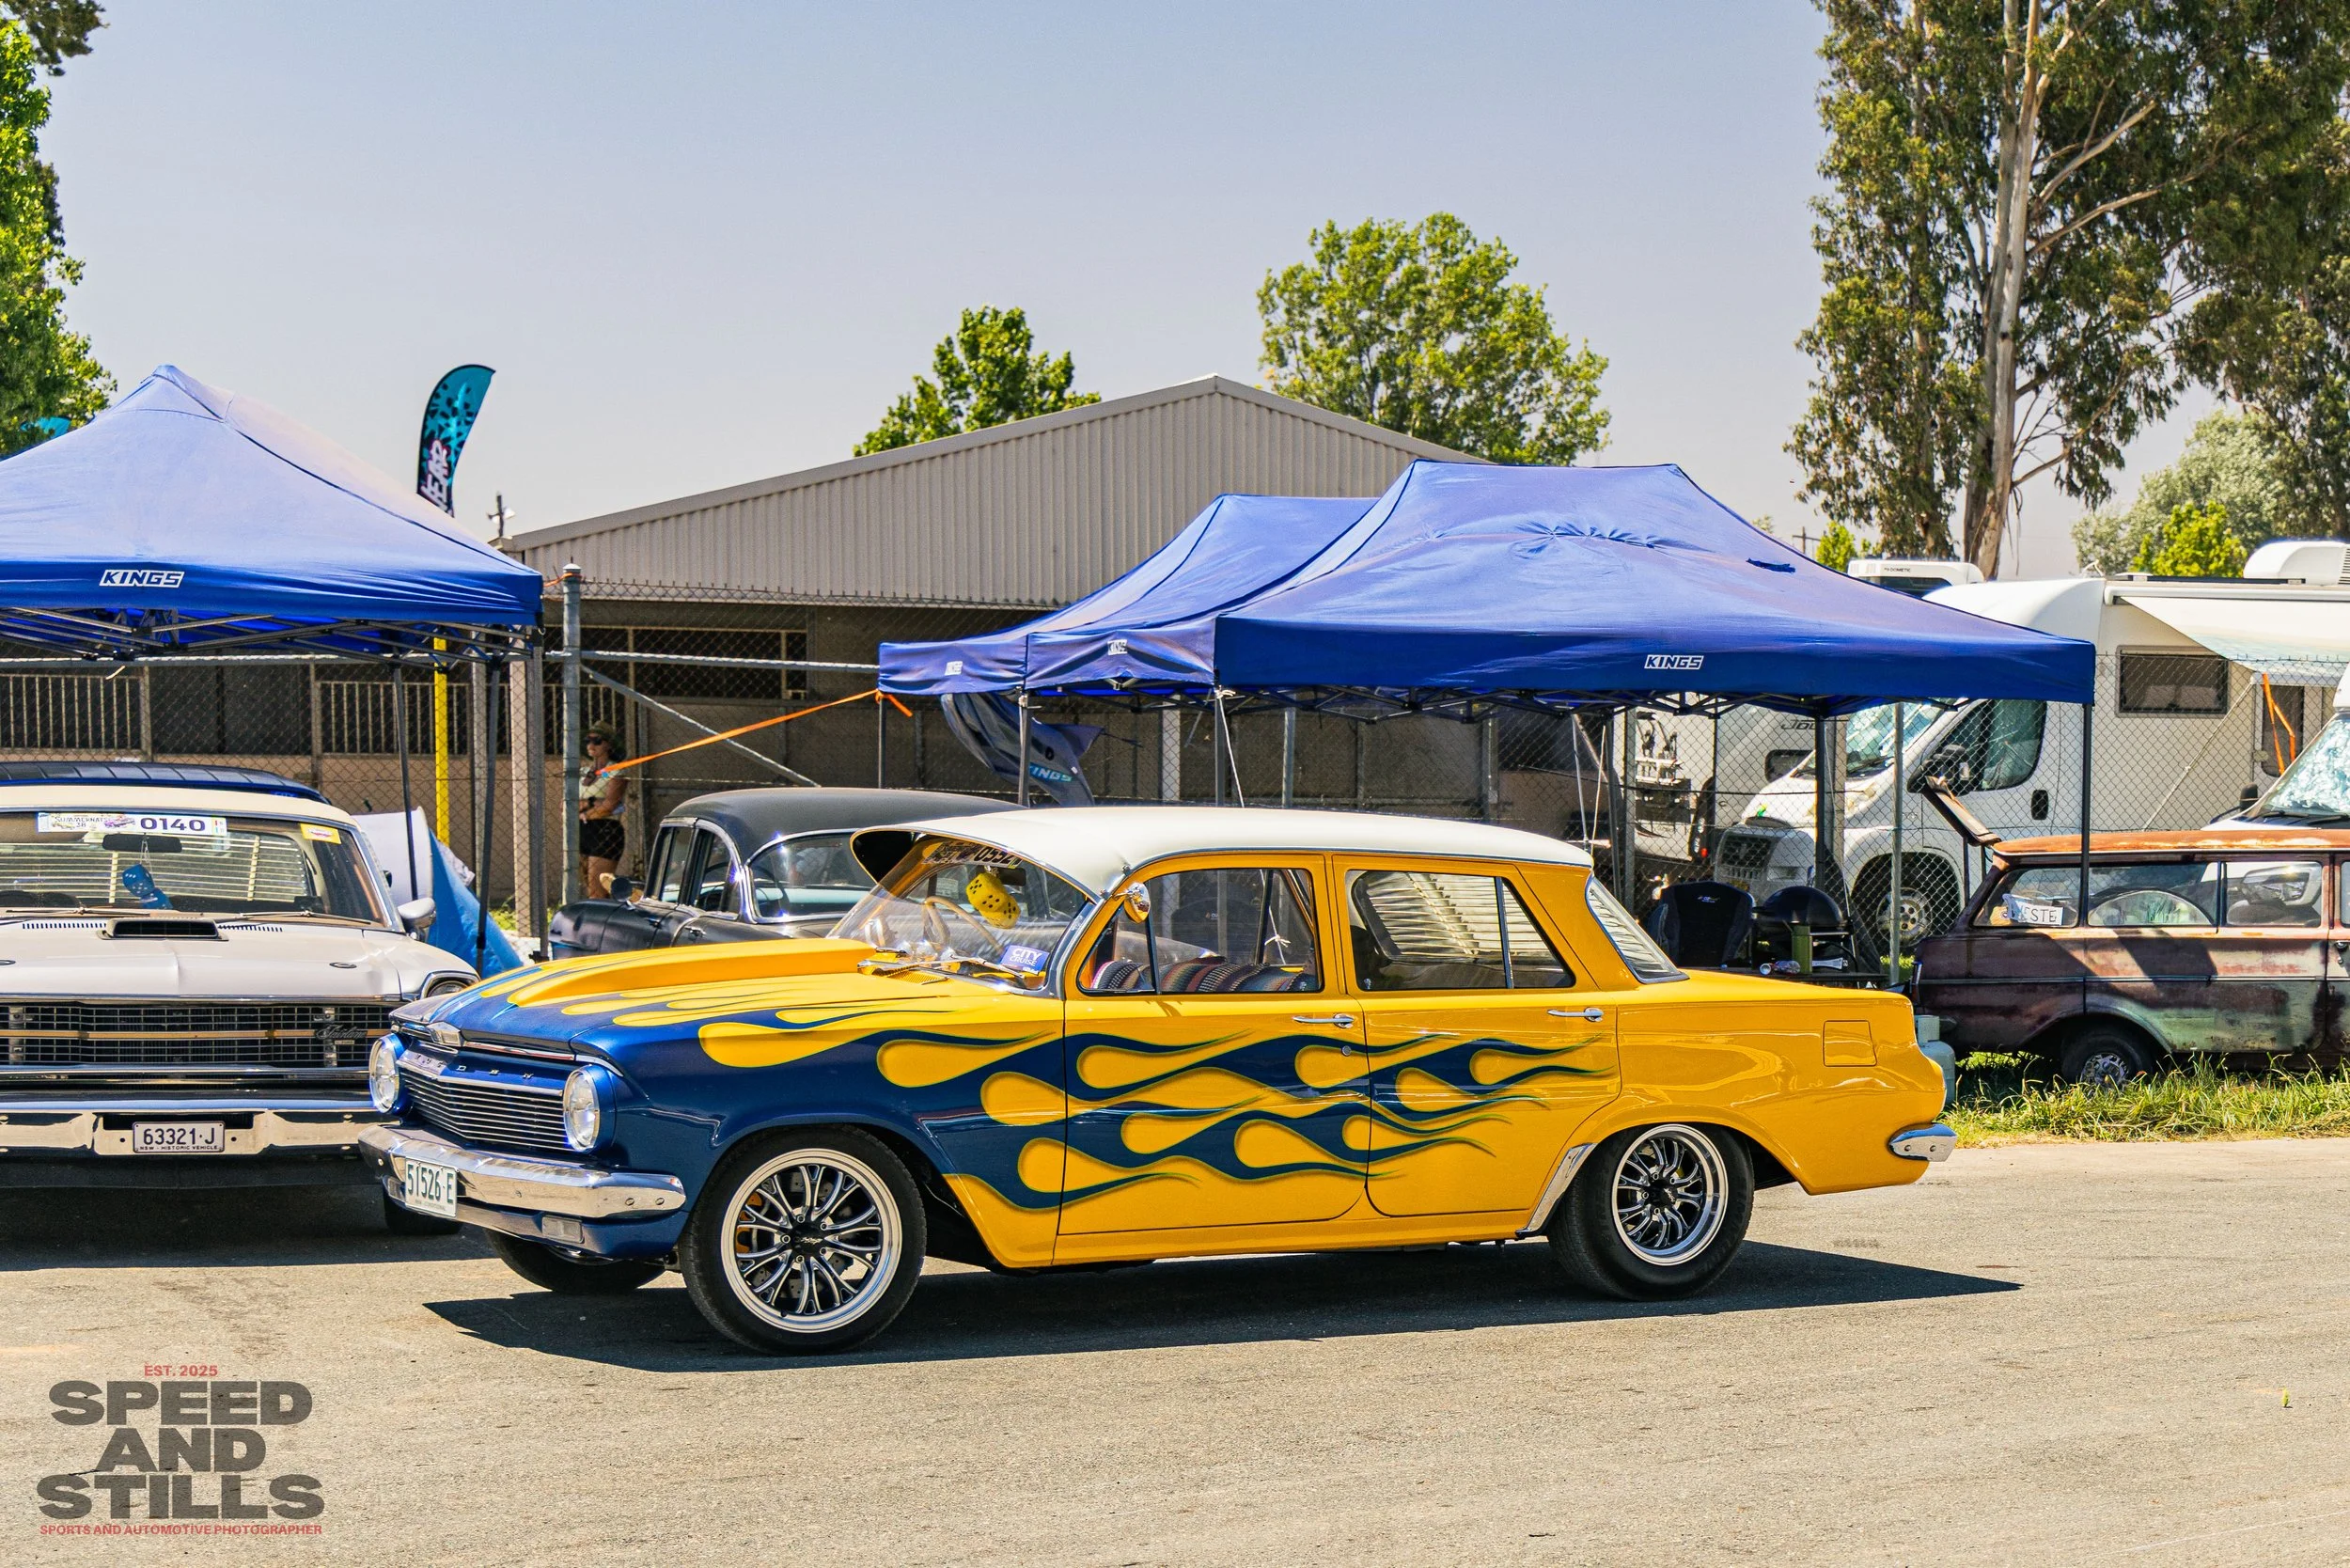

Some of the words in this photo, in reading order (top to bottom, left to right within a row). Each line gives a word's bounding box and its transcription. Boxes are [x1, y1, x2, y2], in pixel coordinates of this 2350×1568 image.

[99, 570, 185, 588] KINGS
[1644, 654, 1704, 669] KINGS
[1029, 764, 1073, 782] INGS
[141, 817, 206, 831] 0140
[1010, 955, 1038, 967] CRUISE
[1012, 948, 1042, 961] CITY
